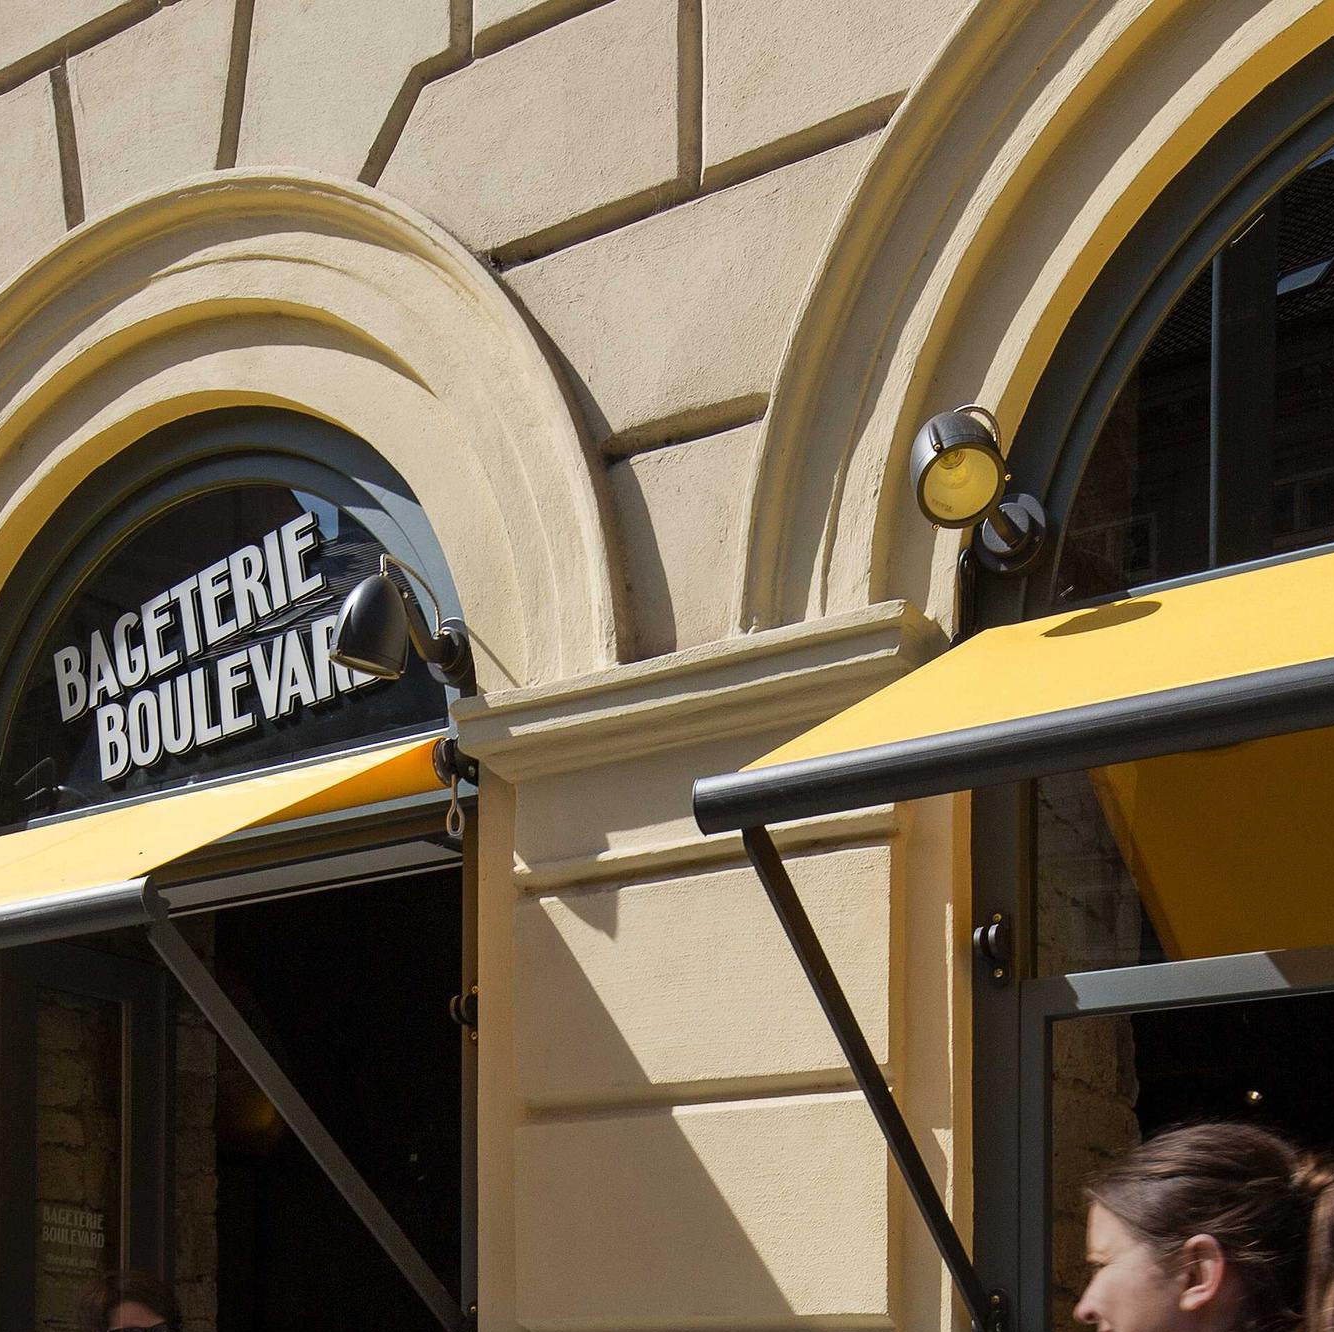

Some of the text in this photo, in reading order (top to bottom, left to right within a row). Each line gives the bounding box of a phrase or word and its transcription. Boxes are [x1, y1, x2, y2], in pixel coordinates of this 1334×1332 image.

[53, 511, 327, 723] BAGETERIE
[96, 614, 380, 782] BOULEVAR
[42, 1226, 105, 1249] BOULEVARD
[43, 1206, 104, 1231] BAGETERIE
